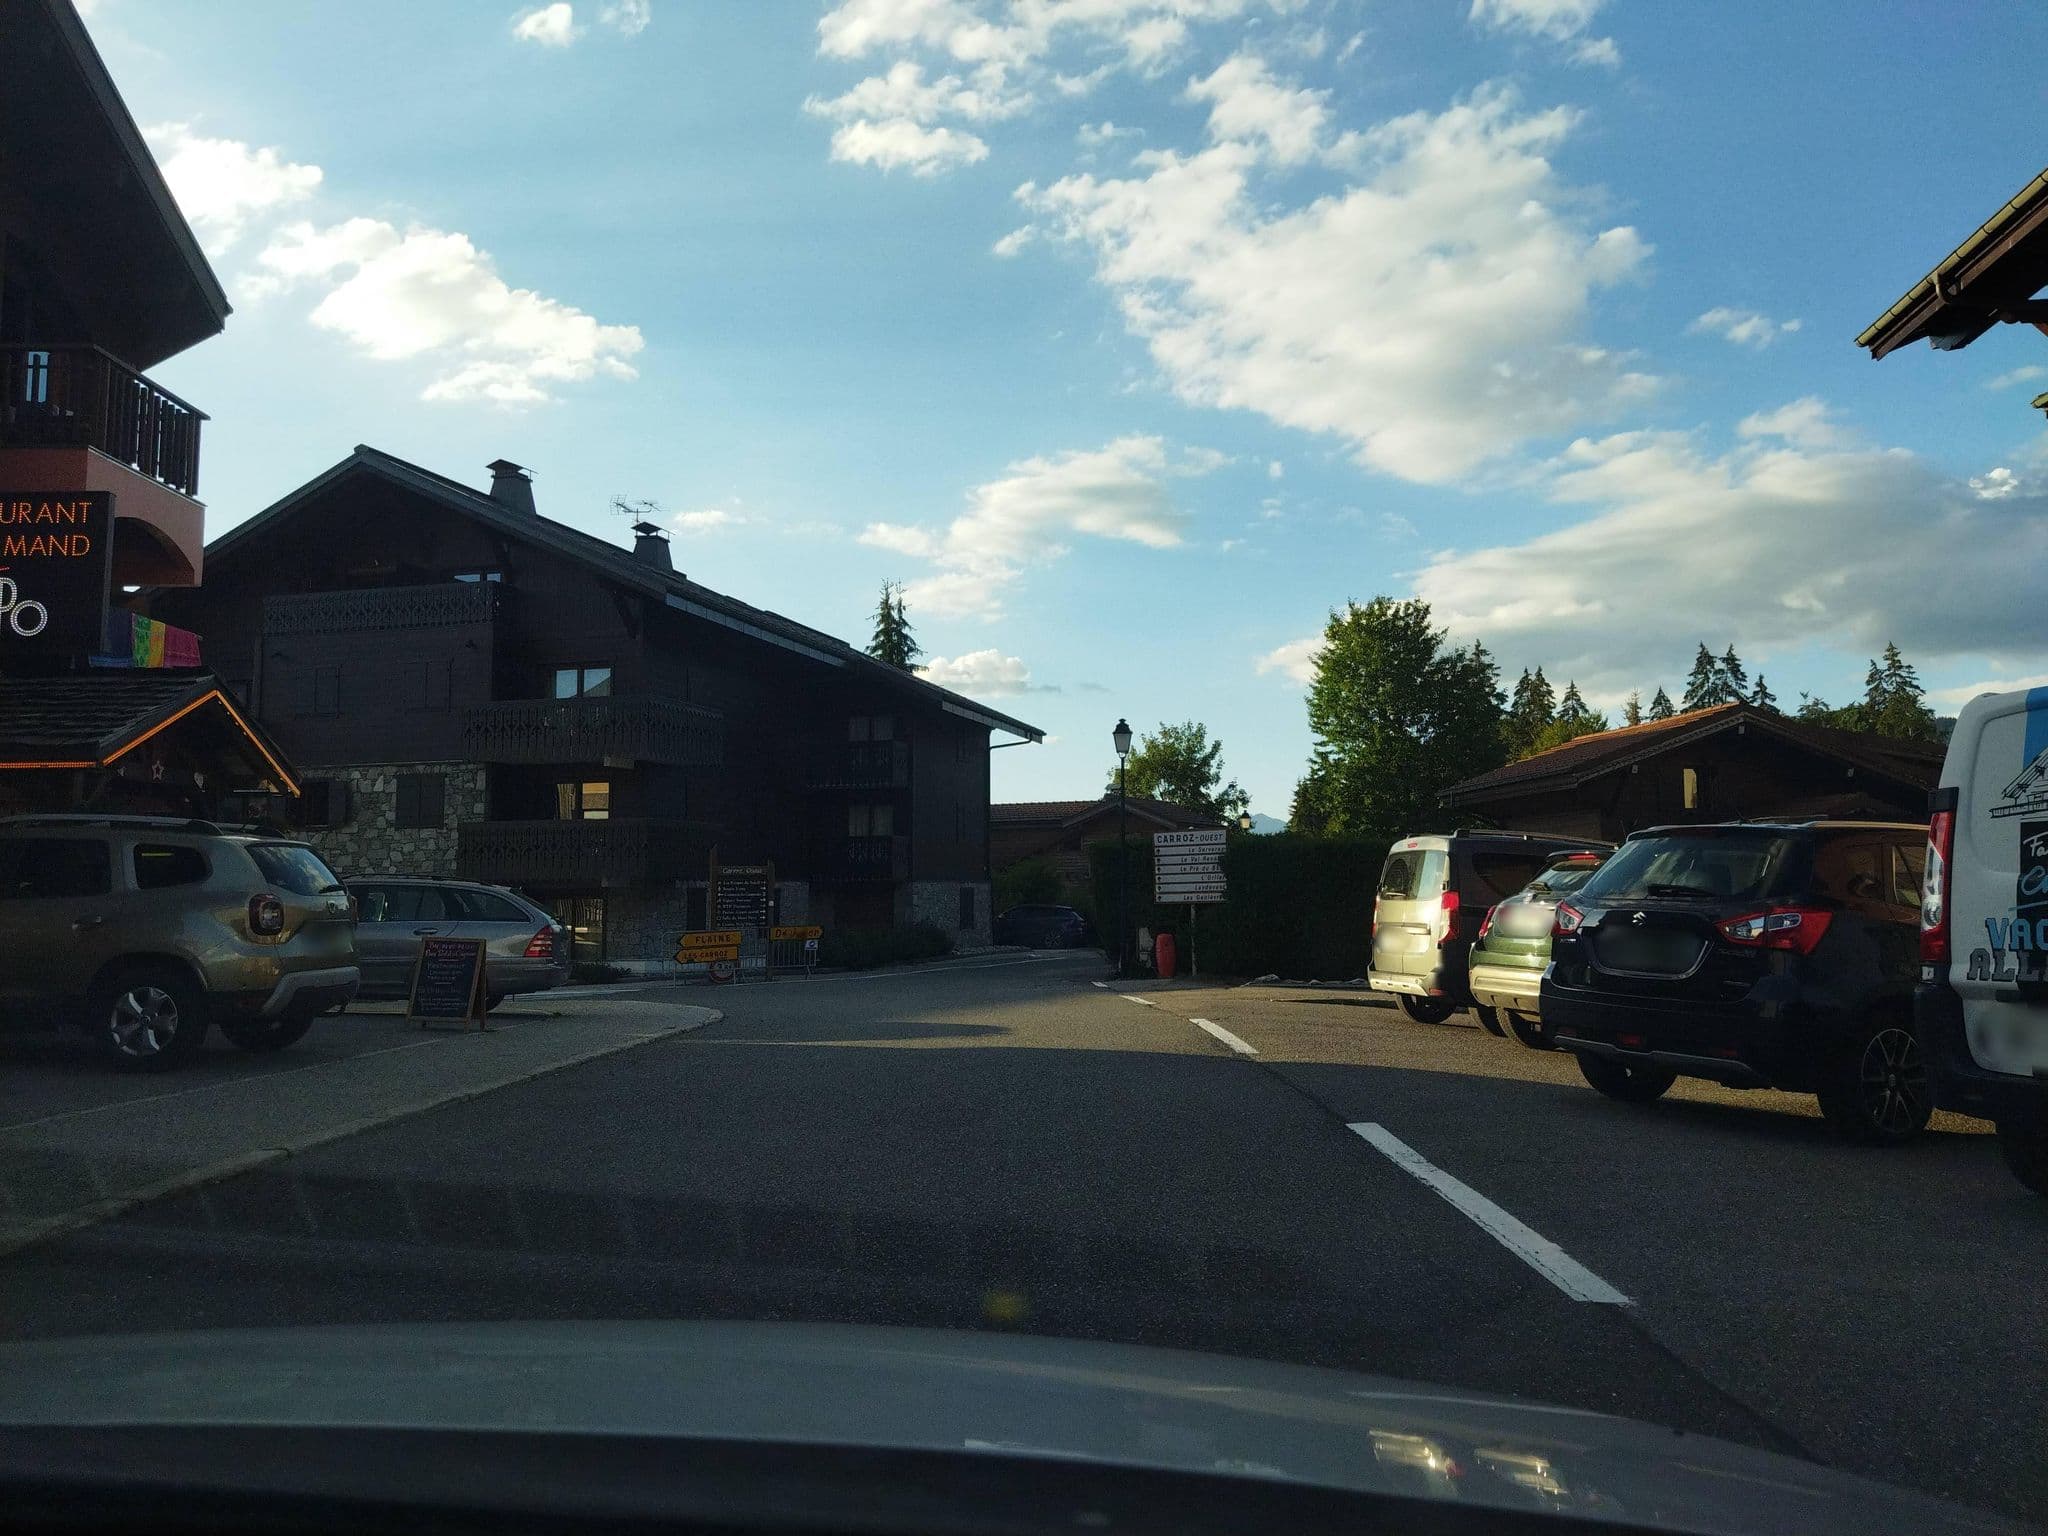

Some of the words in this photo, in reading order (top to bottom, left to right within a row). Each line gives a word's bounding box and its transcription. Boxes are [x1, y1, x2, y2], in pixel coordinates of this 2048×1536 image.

[3, 535, 91, 556] MAND
[1157, 834, 1224, 844] CARROZ-OUEST
[695, 934, 732, 944] FLAINE
[700, 950, 728, 959] CARROZ
